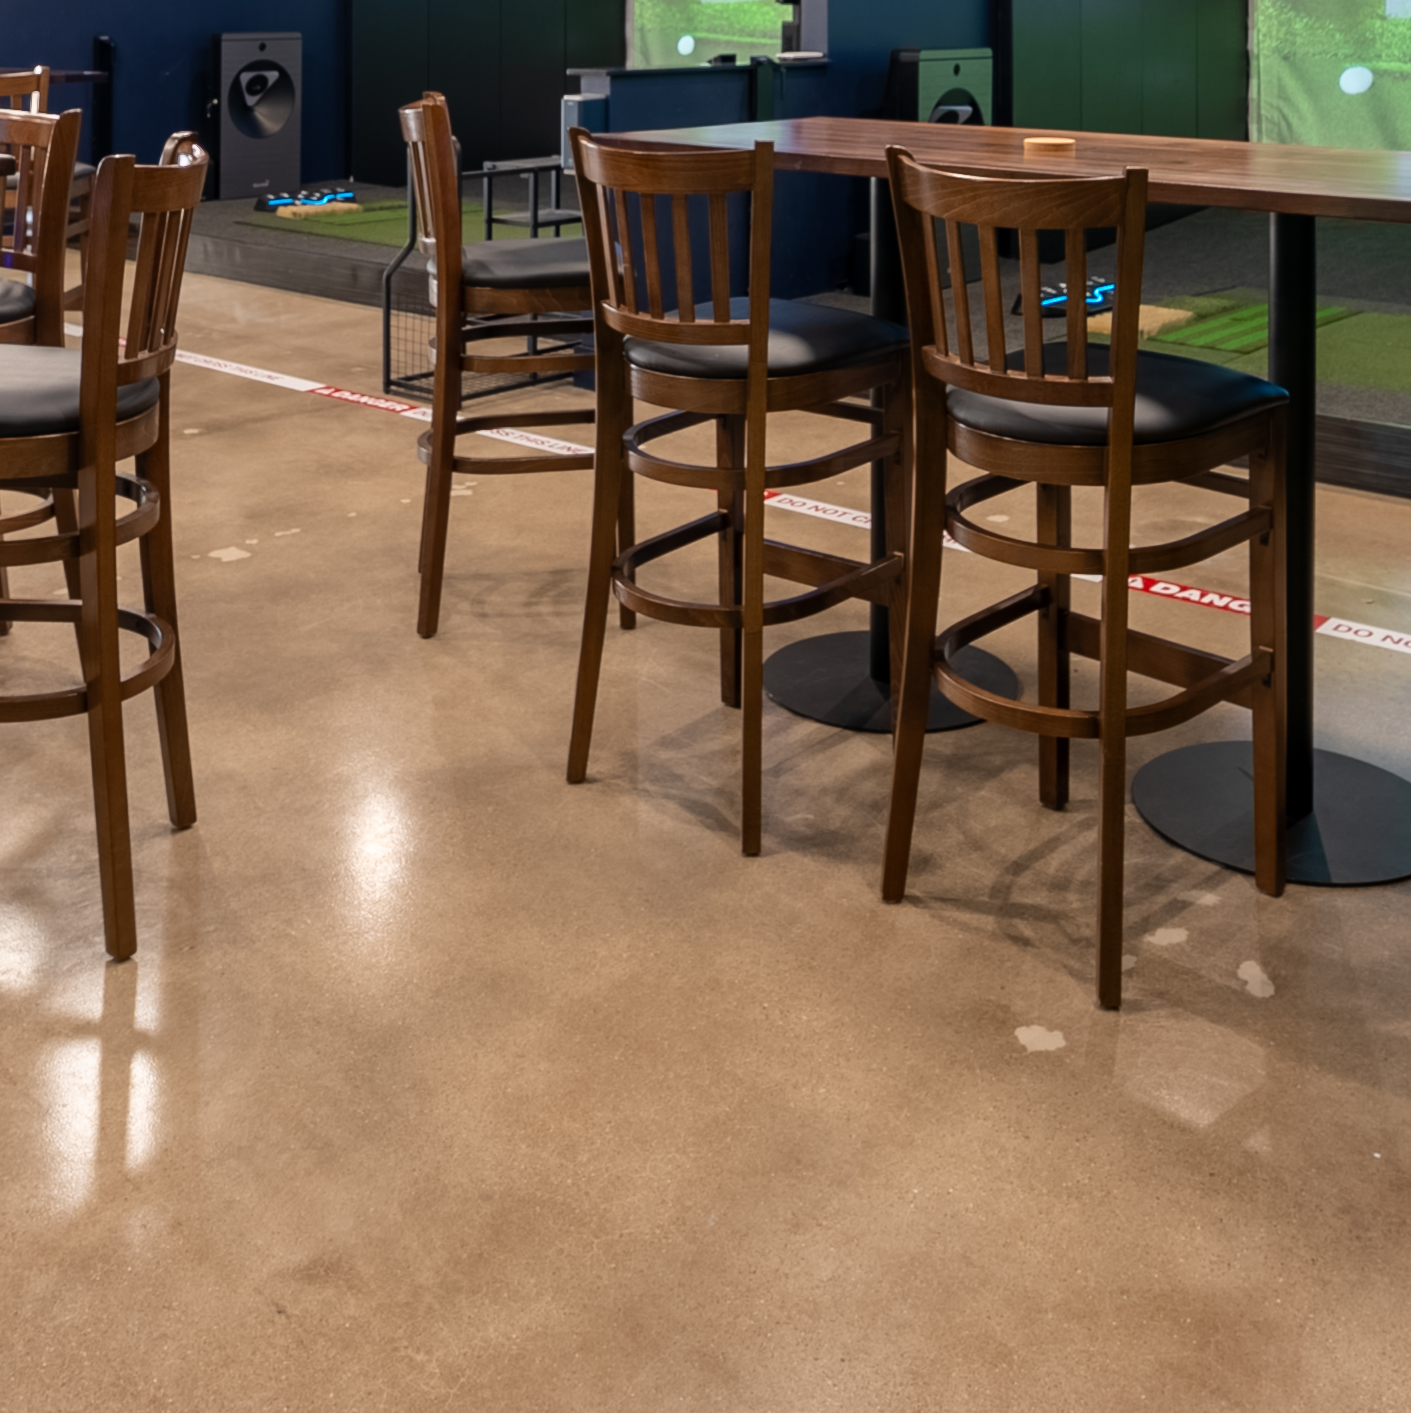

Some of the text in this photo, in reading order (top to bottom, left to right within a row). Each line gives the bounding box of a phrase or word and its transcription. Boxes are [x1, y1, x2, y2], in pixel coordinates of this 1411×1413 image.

[777, 496, 853, 518] DO NOT
[1149, 582, 1252, 614] DANG
[1331, 623, 1374, 638] DO
